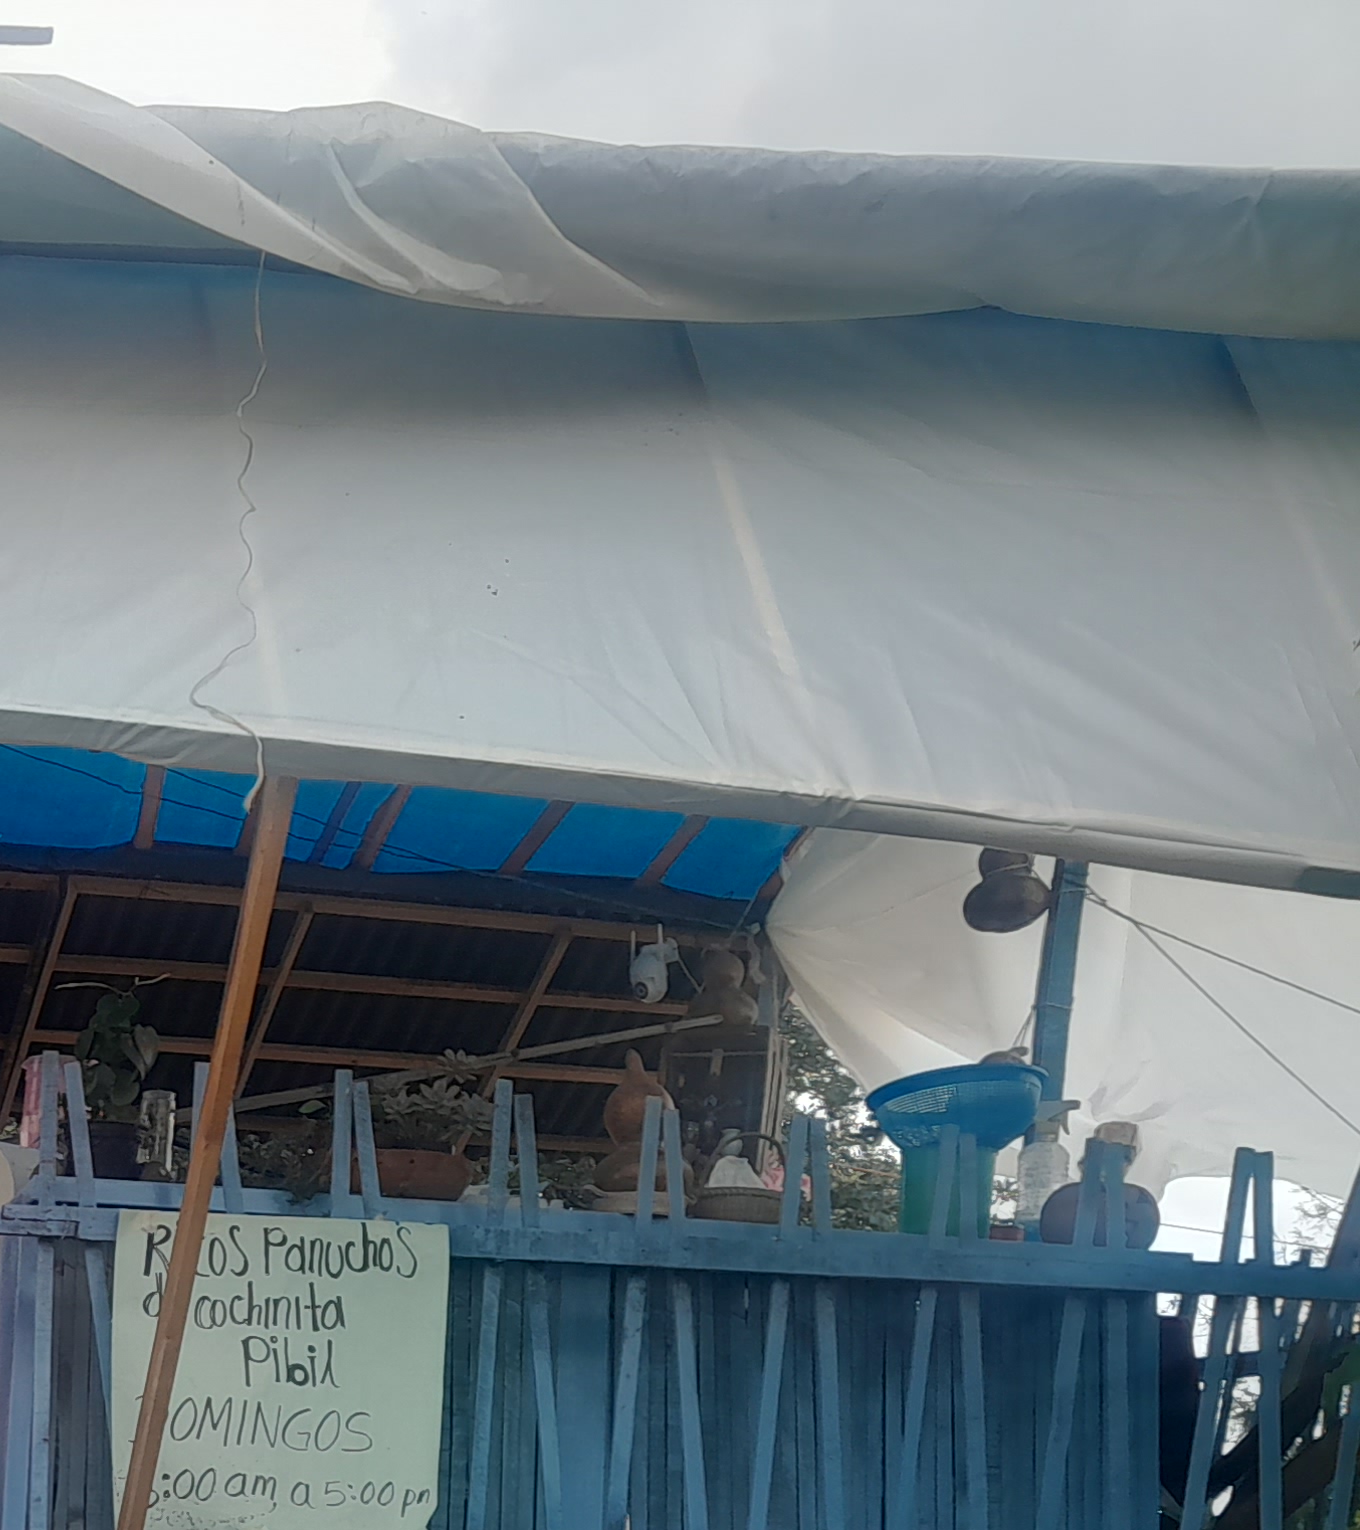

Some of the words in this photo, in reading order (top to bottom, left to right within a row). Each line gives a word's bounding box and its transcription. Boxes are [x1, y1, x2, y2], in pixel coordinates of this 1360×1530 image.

[194, 1281, 347, 1332] cochinita
[241, 1335, 340, 1388] Pibil
[129, 1396, 374, 1453] OMINGOS
[290, 1480, 316, 1510] a
